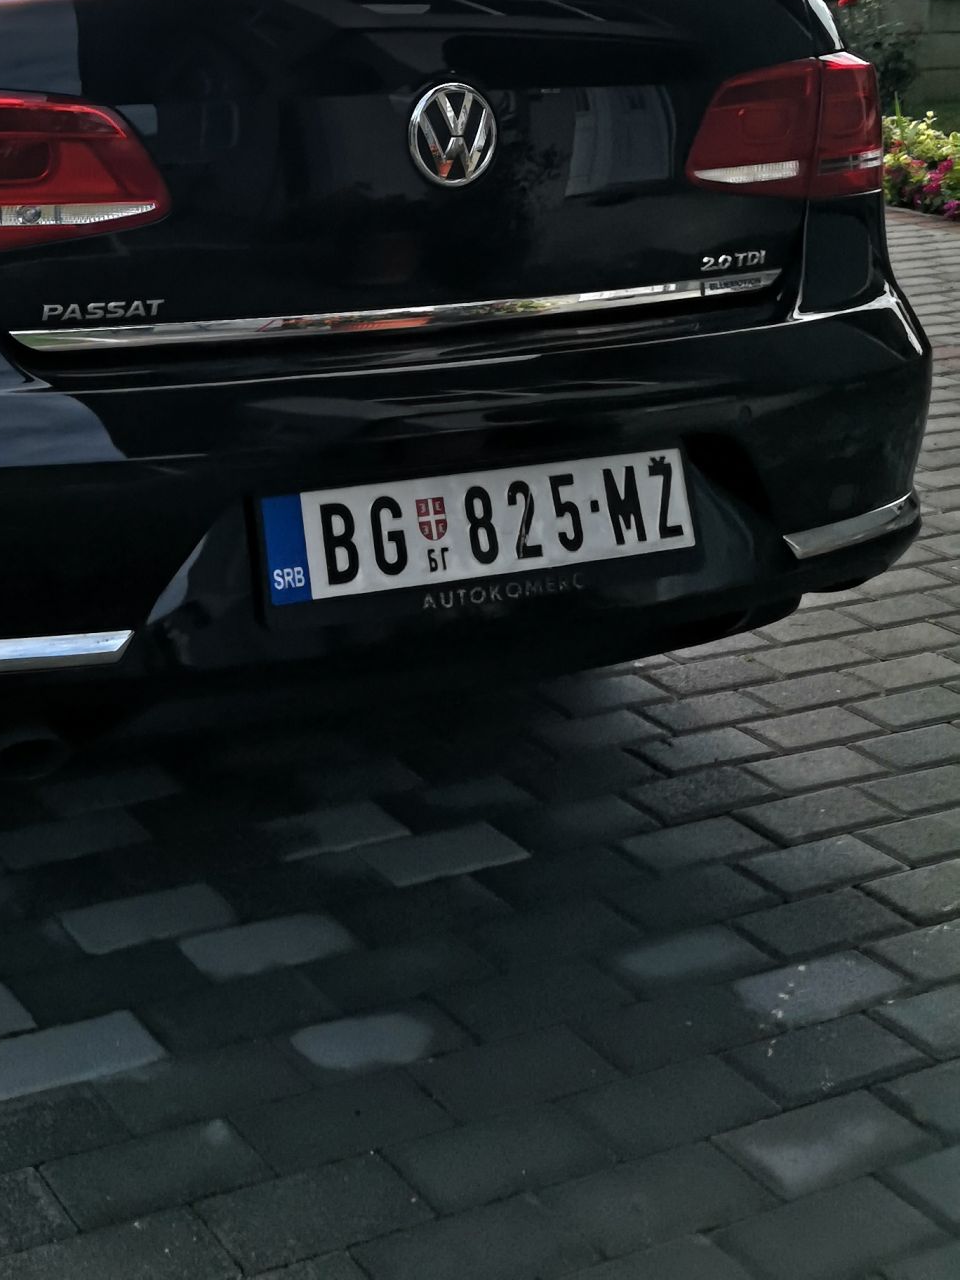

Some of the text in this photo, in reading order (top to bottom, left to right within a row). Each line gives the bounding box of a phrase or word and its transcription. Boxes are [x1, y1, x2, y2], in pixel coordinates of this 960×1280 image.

[734, 249, 767, 267] TDI
[41, 298, 166, 321] PASSAT
[318, 495, 408, 586] BG
[273, 566, 306, 591] SRB
